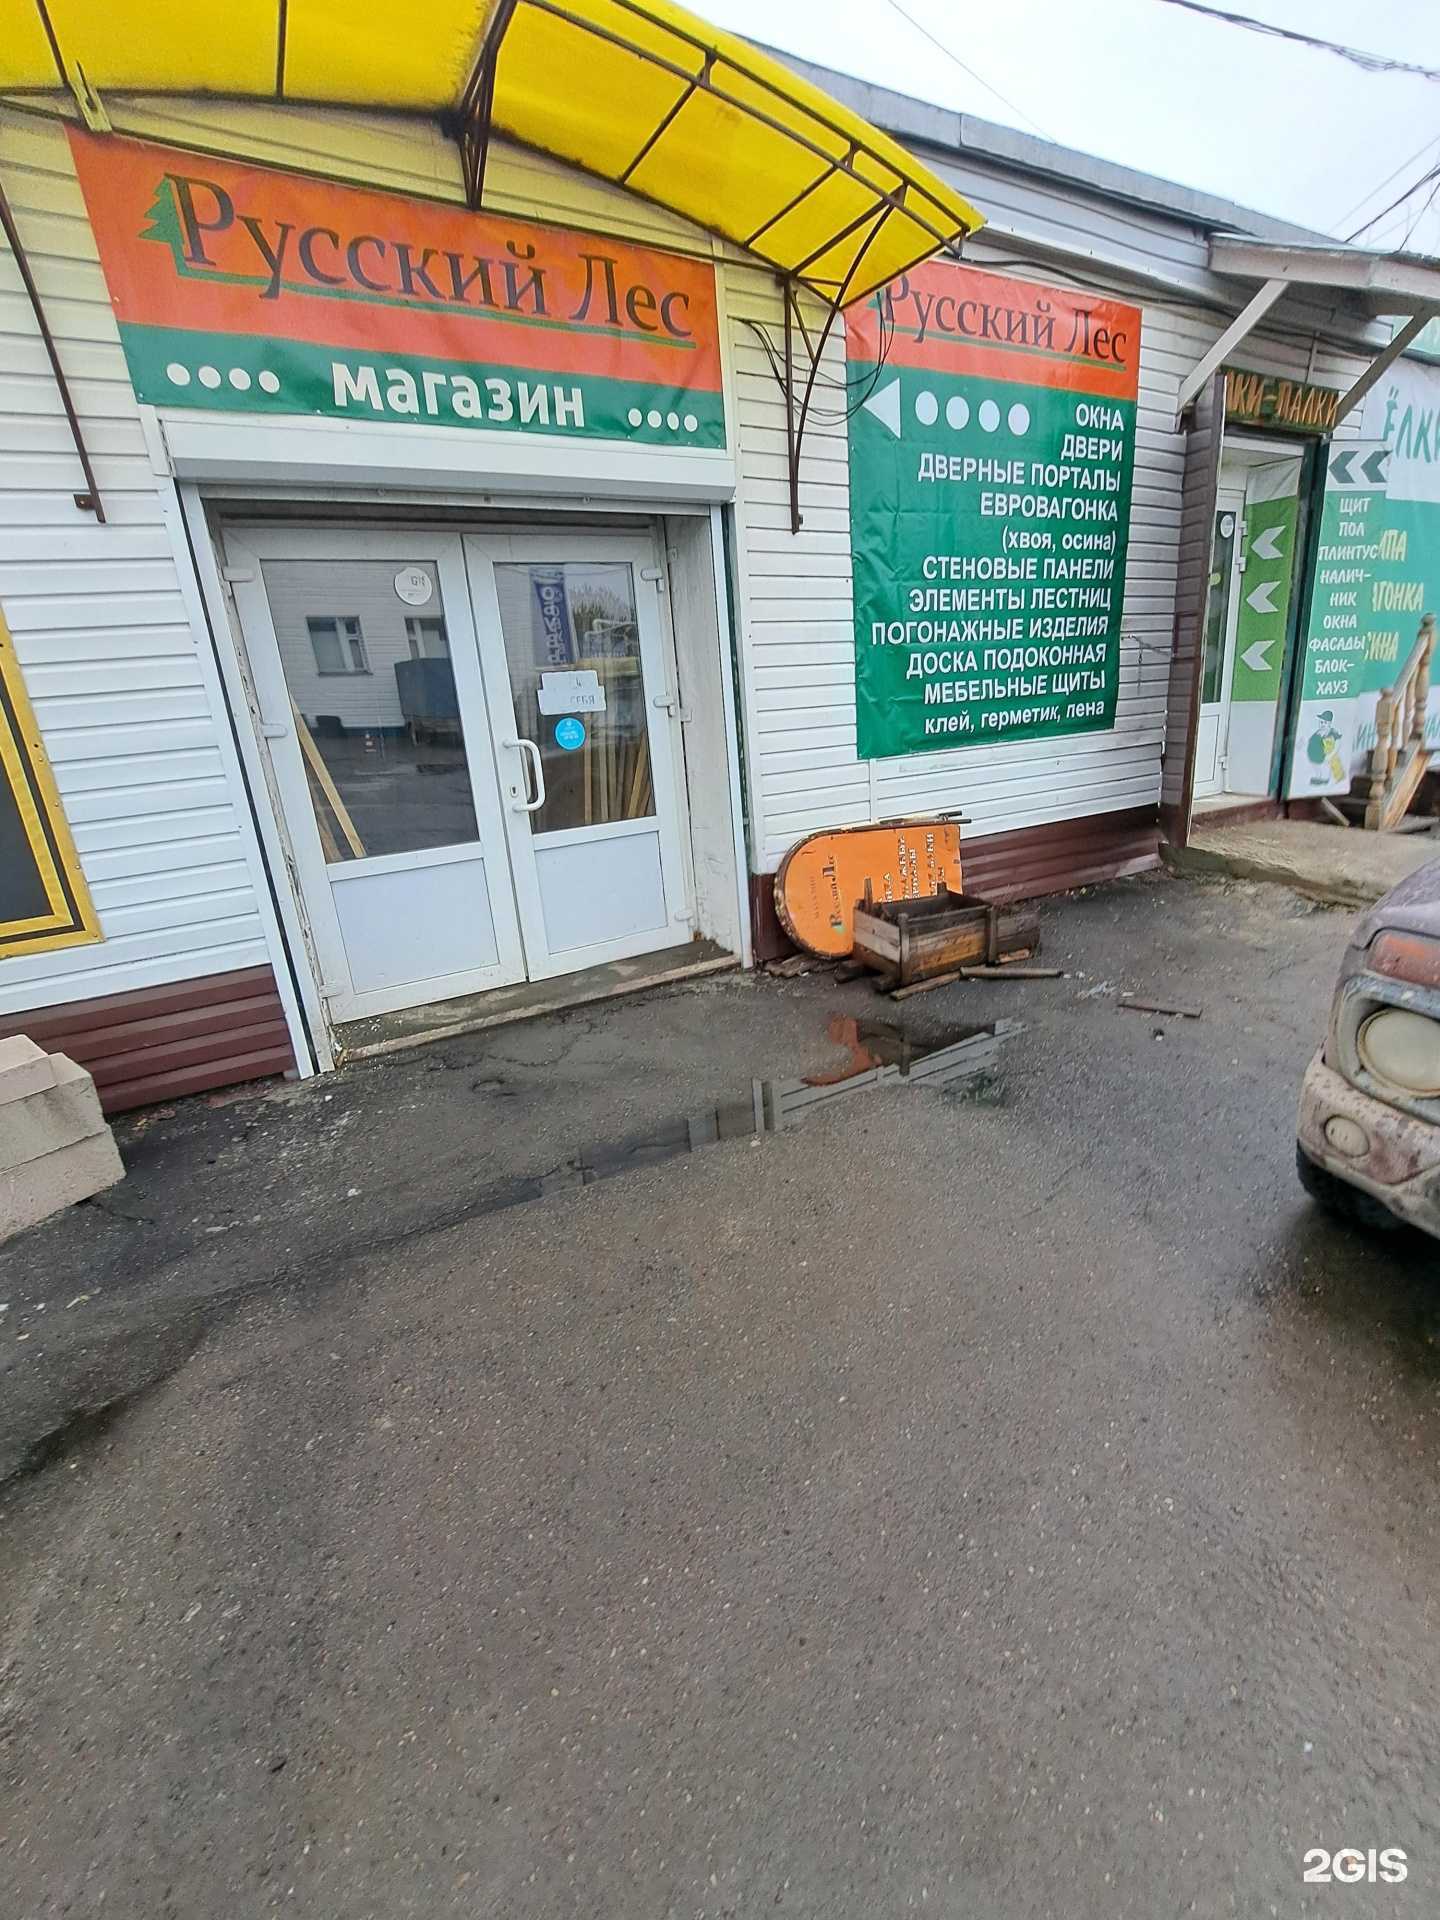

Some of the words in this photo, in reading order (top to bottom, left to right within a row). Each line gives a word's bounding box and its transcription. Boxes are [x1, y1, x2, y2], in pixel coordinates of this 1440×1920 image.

[165, 173, 551, 318] Русский
[568, 253, 692, 338] Лес
[1064, 308, 1127, 364] Лес
[1075, 402, 1125, 432] ОКНА
[1060, 434, 1123, 462] ДВЕРИ
[917, 453, 1025, 485] ДВЕРНЫЕ
[1031, 463, 1121, 493] ПОРТАЛЫ
[980, 492, 1119, 522] ЕВРОВАГОНКА
[1339, 497, 1371, 516] ЩИТ
[1002, 526, 1056, 554] (хвоя,
[1061, 529, 1116, 556] осина)
[1338, 521, 1365, 537] ПОЛ
[1318, 544, 1378, 561] ПЛИНТУС
[922, 556, 1037, 580] СТЕНОВЫЕ
[1043, 558, 1115, 580] ПАНЕЛИ
[1319, 568, 1371, 585] НАЛИЧ-
[908, 588, 1025, 612] ЭЛЕМЕНТЫ
[1030, 587, 1112, 612] ЛЕСТНИЦ
[1330, 592, 1357, 607] НИК
[872, 618, 1023, 645] ПОГОНАЖНЫЕ
[1029, 615, 1109, 641] ИЗДЕЛИЯ
[1323, 614, 1357, 630] ОКНА
[1309, 635, 1366, 652] ФАСАДЫ
[906, 650, 978, 680] ДОСКА
[983, 643, 1106, 676] ПОДОКОННАЯ
[1315, 658, 1355, 674] БЛОК-
[924, 676, 1047, 705] МЕБЕЛЬНЫЕ
[1052, 669, 1105, 697] ЩИТЫ
[1316, 679, 1348, 695] ХАУЗ
[925, 709, 975, 734] клей,
[980, 702, 1062, 730] герметик,
[1066, 700, 1105, 720] пена
